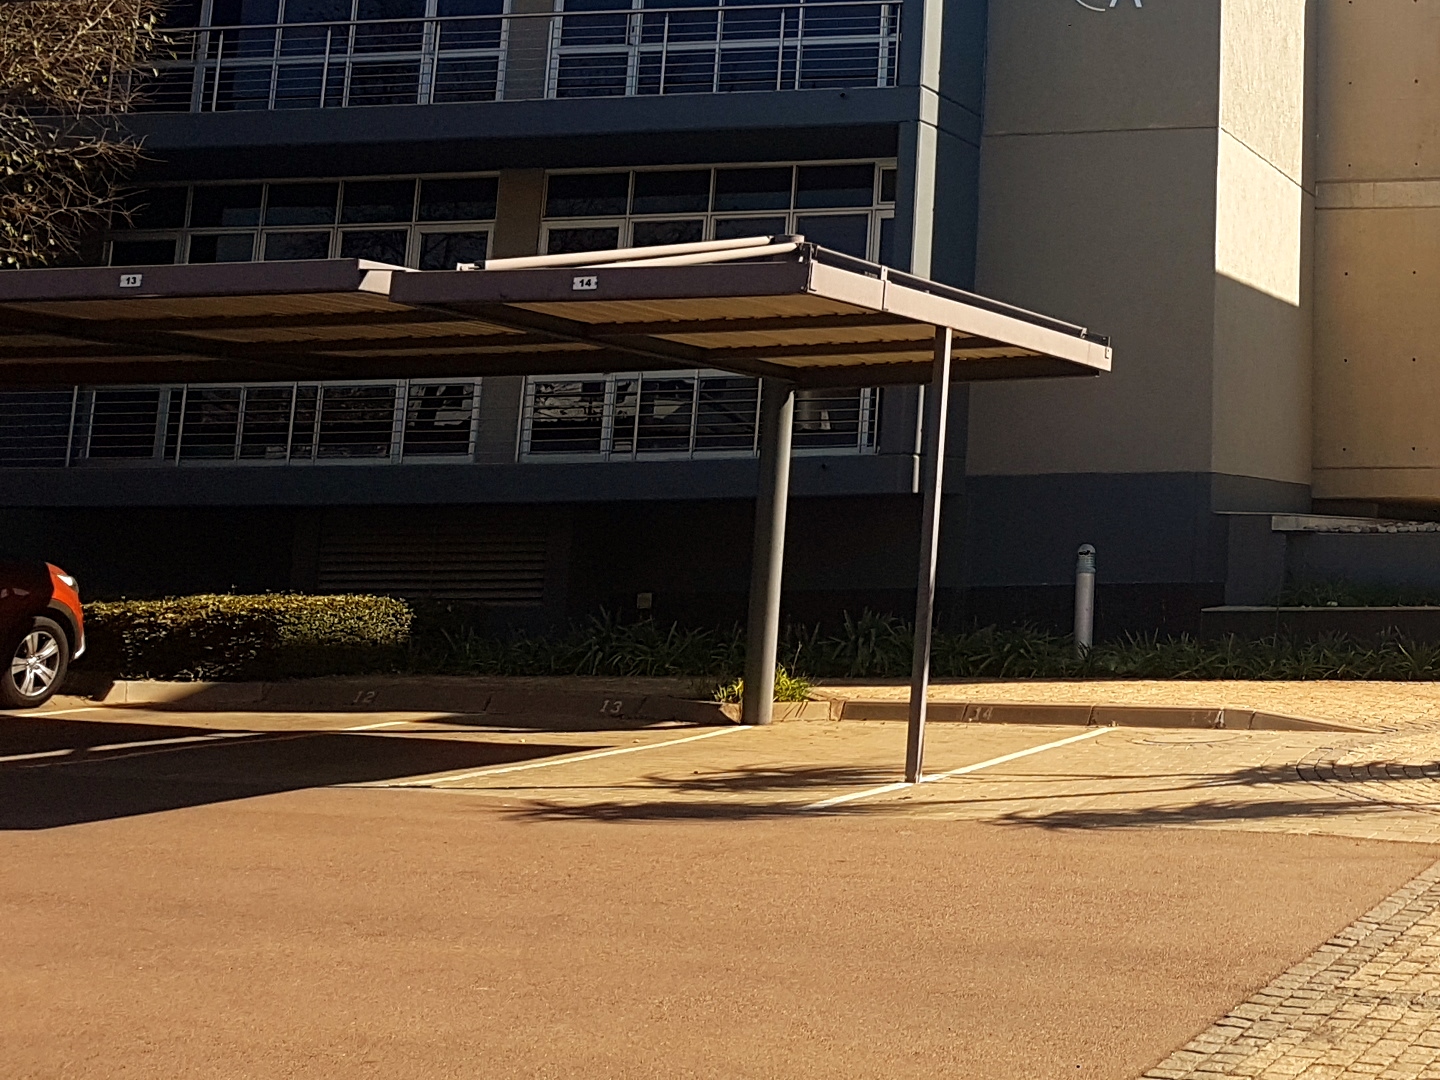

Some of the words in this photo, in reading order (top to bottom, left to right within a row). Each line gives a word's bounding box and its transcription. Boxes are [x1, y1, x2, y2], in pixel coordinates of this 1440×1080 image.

[125, 276, 137, 285] 13
[579, 278, 592, 288] 14
[352, 690, 375, 703] 12
[600, 700, 622, 713] 13
